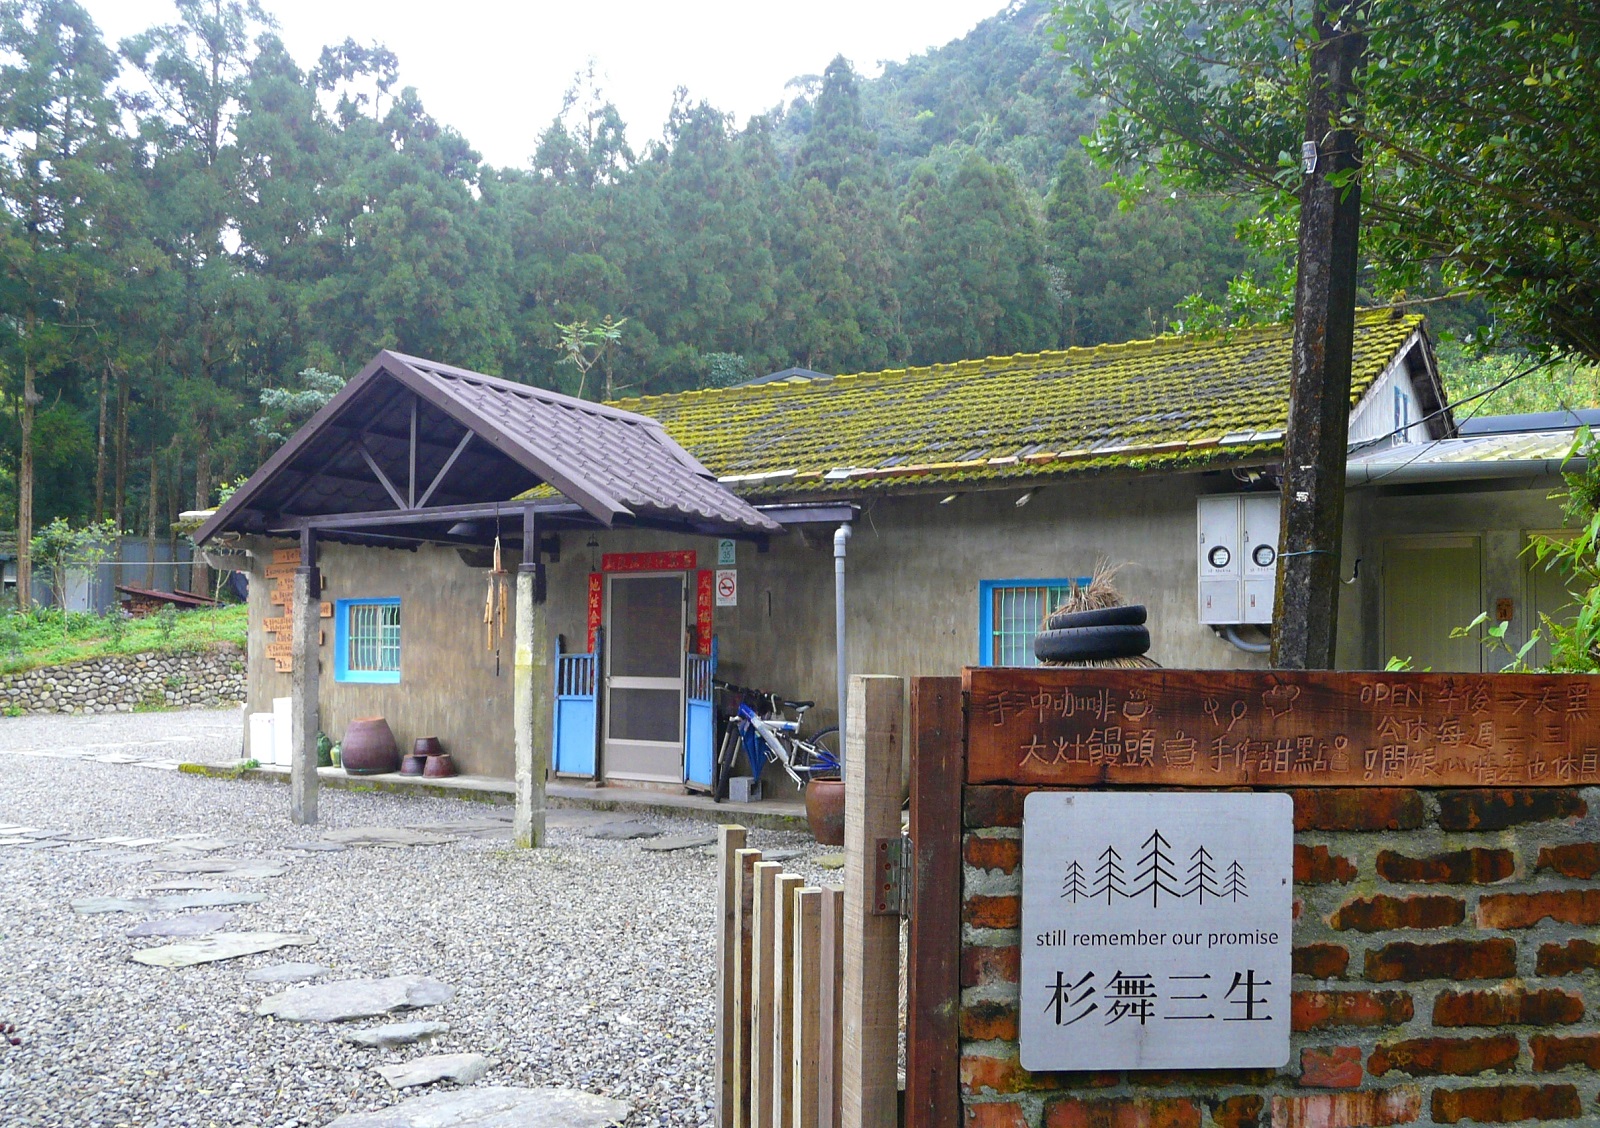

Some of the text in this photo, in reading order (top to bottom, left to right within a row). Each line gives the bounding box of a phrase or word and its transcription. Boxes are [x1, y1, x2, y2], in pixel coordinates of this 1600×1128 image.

[1019, 726, 1329, 773] 大灶饅頭 手作甜點
[1036, 929, 1279, 949] still remember our promise
[1043, 969, 1273, 1027] 杉舞三生
